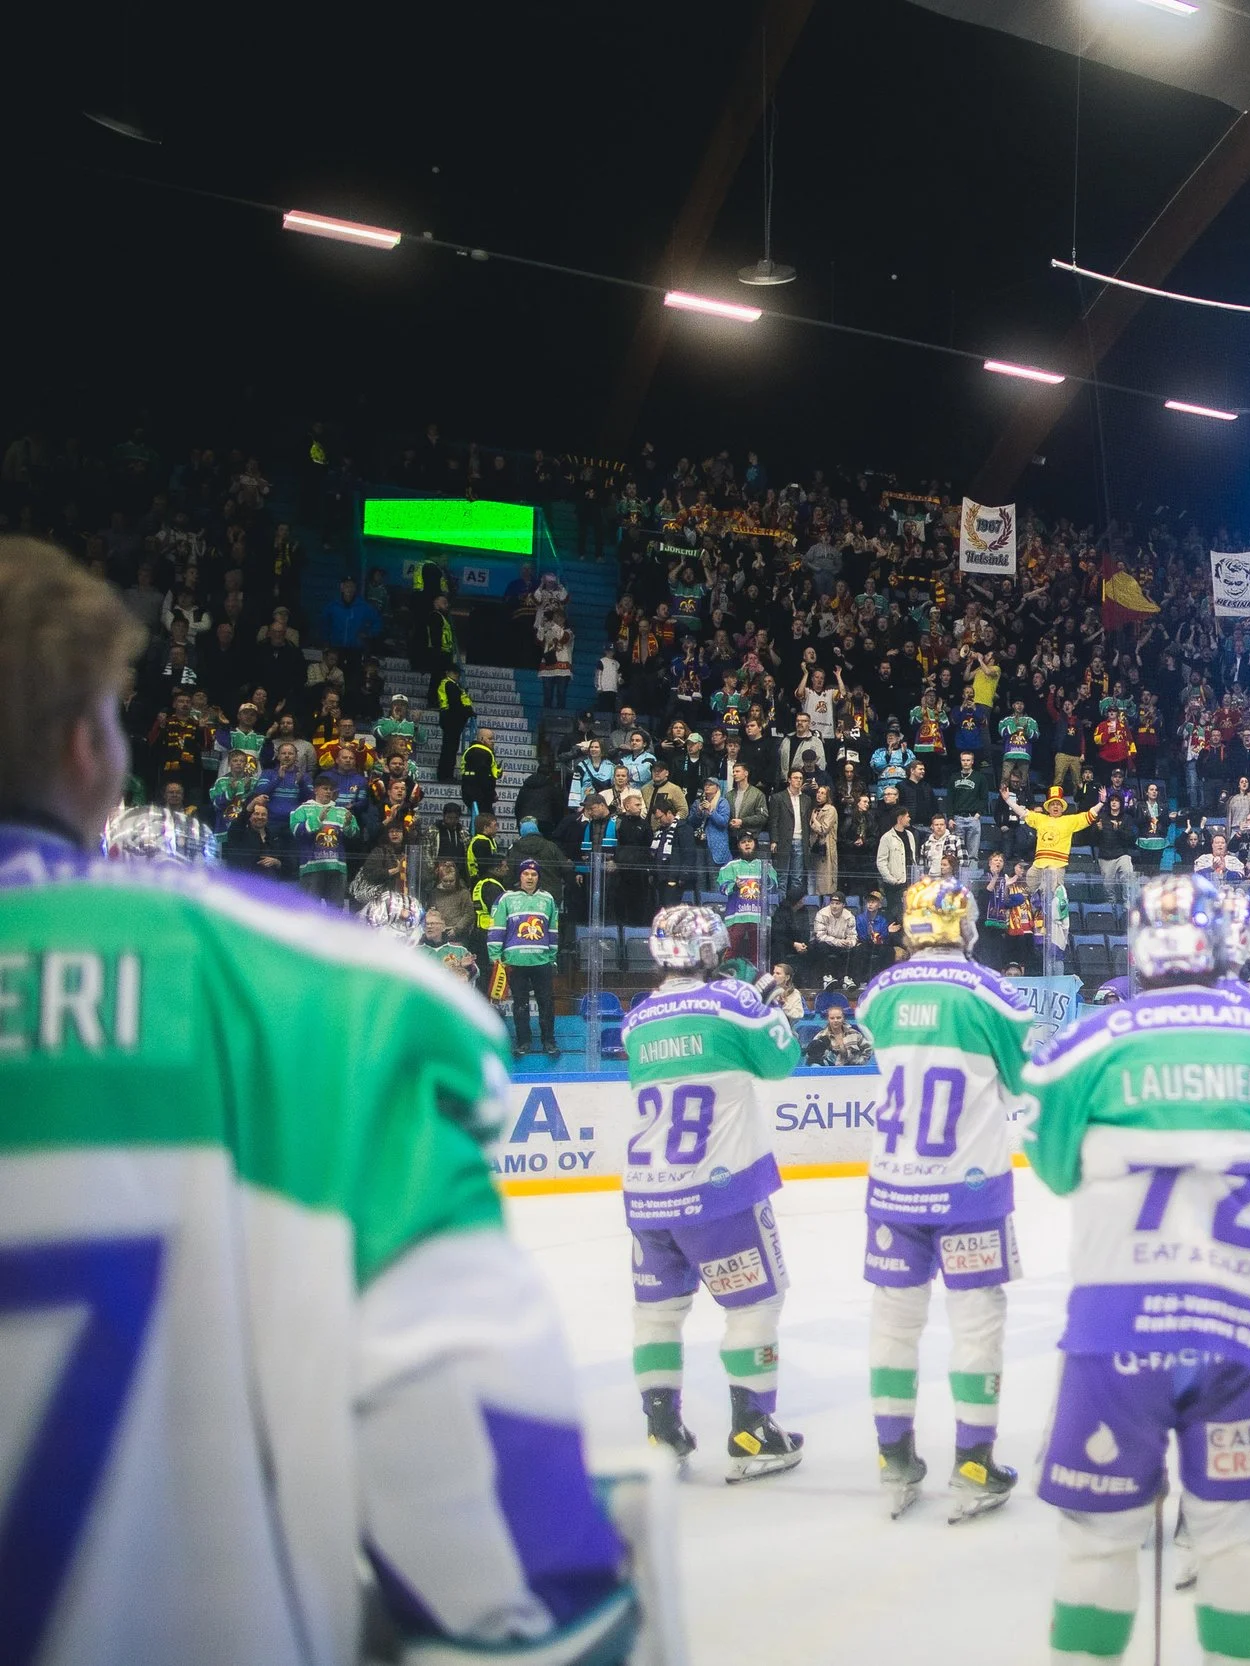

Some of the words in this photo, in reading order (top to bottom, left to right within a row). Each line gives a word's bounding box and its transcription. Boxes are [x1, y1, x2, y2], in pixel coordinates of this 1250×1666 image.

[976, 518, 1004, 533] 1967
[965, 549, 1009, 568] Helsinki
[466, 570, 488, 583] A5
[638, 999, 721, 1021] CIRCULATION
[899, 1002, 938, 1027] SUNI
[639, 1034, 704, 1065] AHONEN
[876, 1064, 967, 1158] 40
[627, 1084, 716, 1166] 28
[558, 1150, 596, 1170] OY
[942, 1233, 1000, 1253] CABLE
[702, 1250, 761, 1279] CABLE
[945, 1252, 998, 1270] CREW
[709, 1267, 762, 1293] CREW
[1051, 1462, 1140, 1496] INFUEL
